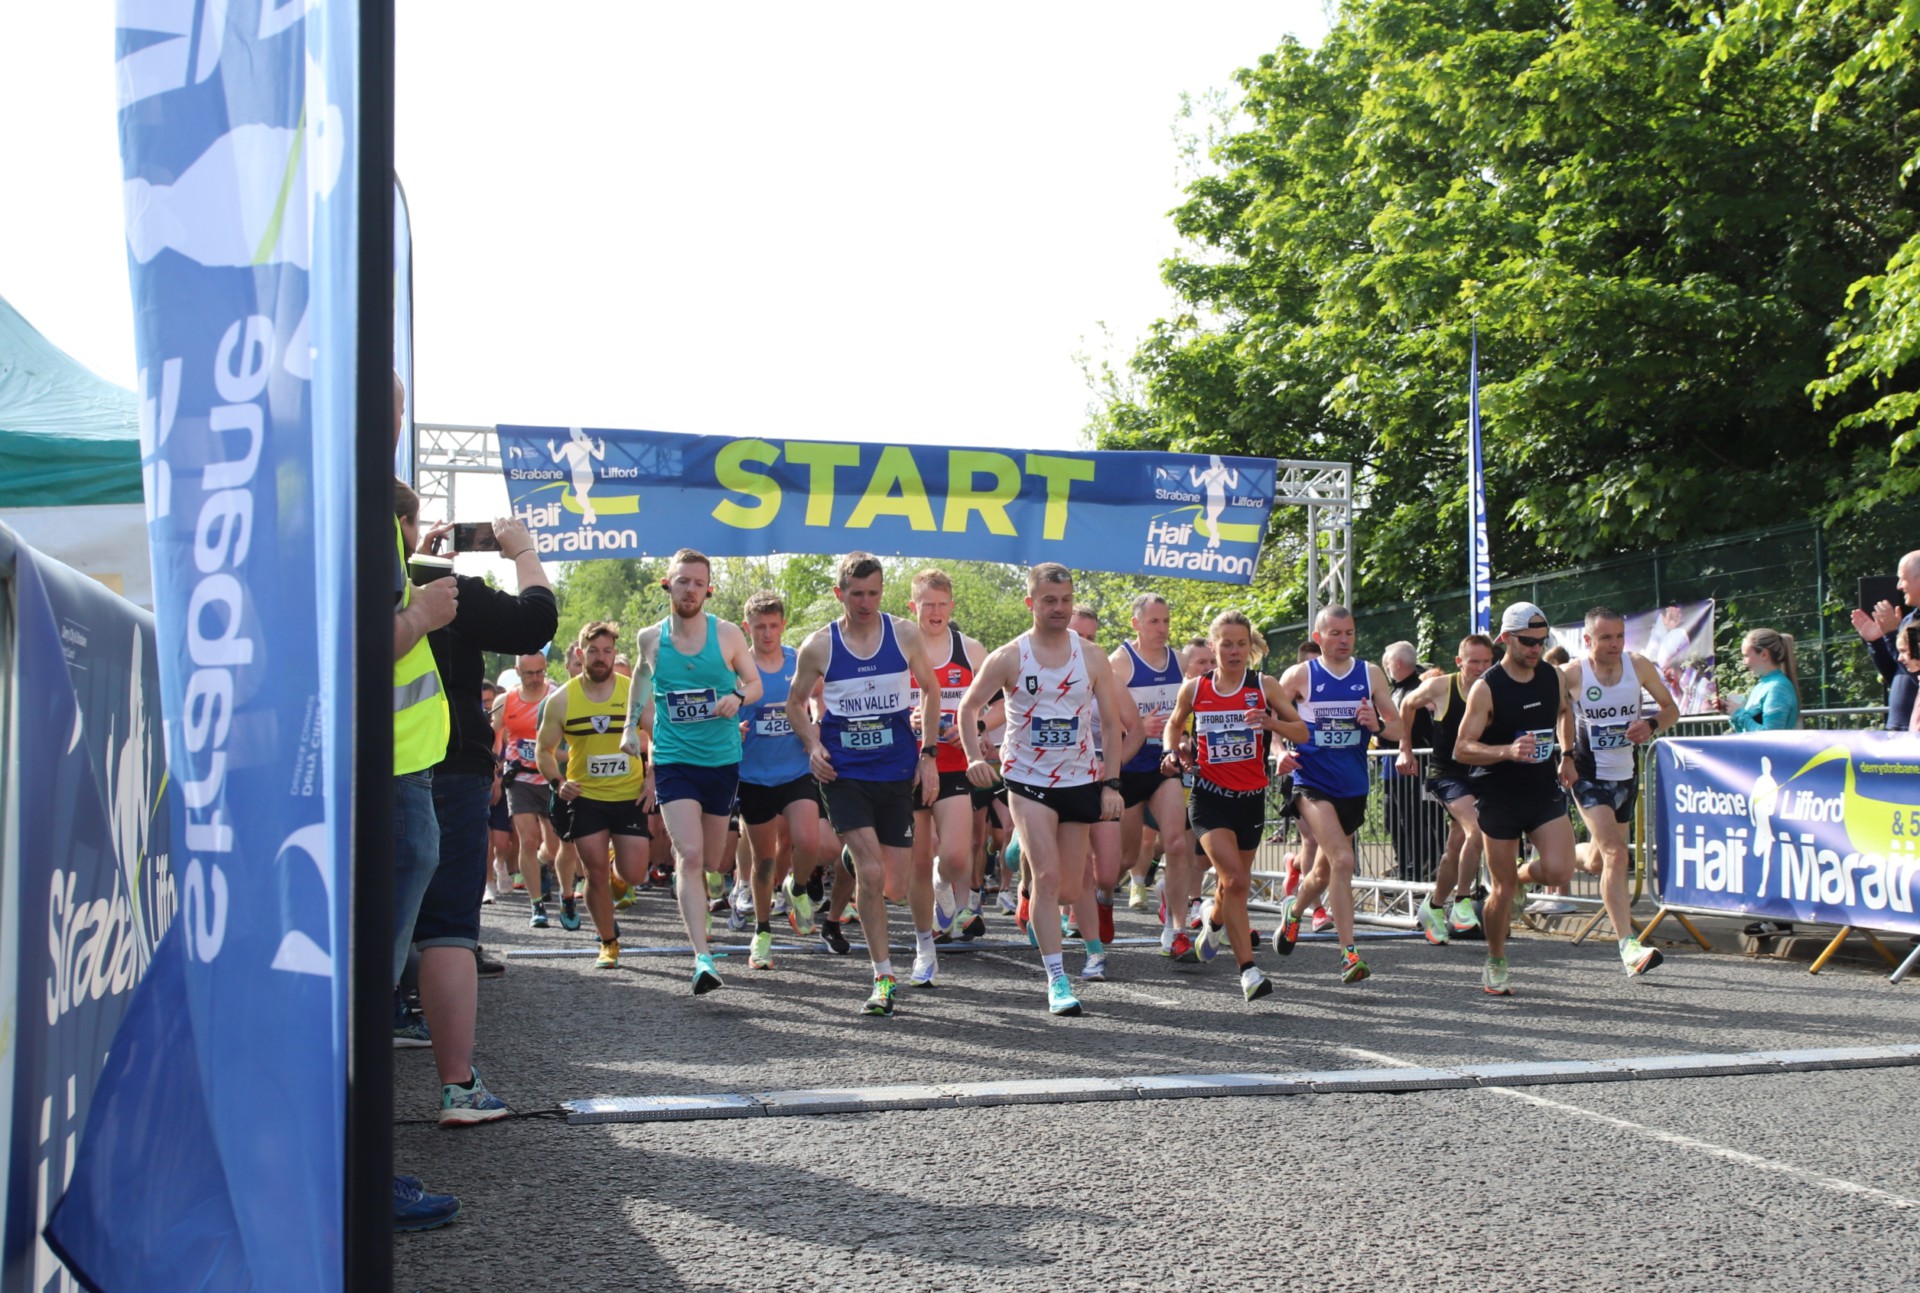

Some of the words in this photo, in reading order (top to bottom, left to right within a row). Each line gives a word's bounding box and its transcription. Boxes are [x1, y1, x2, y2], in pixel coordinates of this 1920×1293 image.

[510, 468, 563, 480] Strabane
[601, 467, 638, 479] Lifford
[711, 437, 1095, 541] START
[1155, 488, 1201, 503] Strabane
[1231, 496, 1264, 508] Lifford
[513, 503, 561, 529] Half
[1147, 521, 1193, 546] Half
[1143, 543, 1253, 576] Marathon
[839, 698, 862, 713] FINN
[863, 693, 900, 711] VALLEY
[676, 704, 709, 718] 604
[1330, 707, 1356, 717] VALLEY
[1585, 707, 1617, 720] SLIGO
[764, 720, 791, 733] 426
[850, 731, 883, 746] 288
[1038, 731, 1071, 744] 533
[1323, 731, 1353, 745] 337
[1598, 735, 1626, 747] 672
[523, 749, 535, 759] 19
[1211, 743, 1253, 759] 1366
[590, 760, 626, 774] 5774
[1196, 777, 1235, 799] NIKE
[1675, 784, 1748, 816] Strabane
[1779, 790, 1845, 823] Lifford
[1892, 810, 1904, 836] &
[1675, 824, 1748, 894] Half
